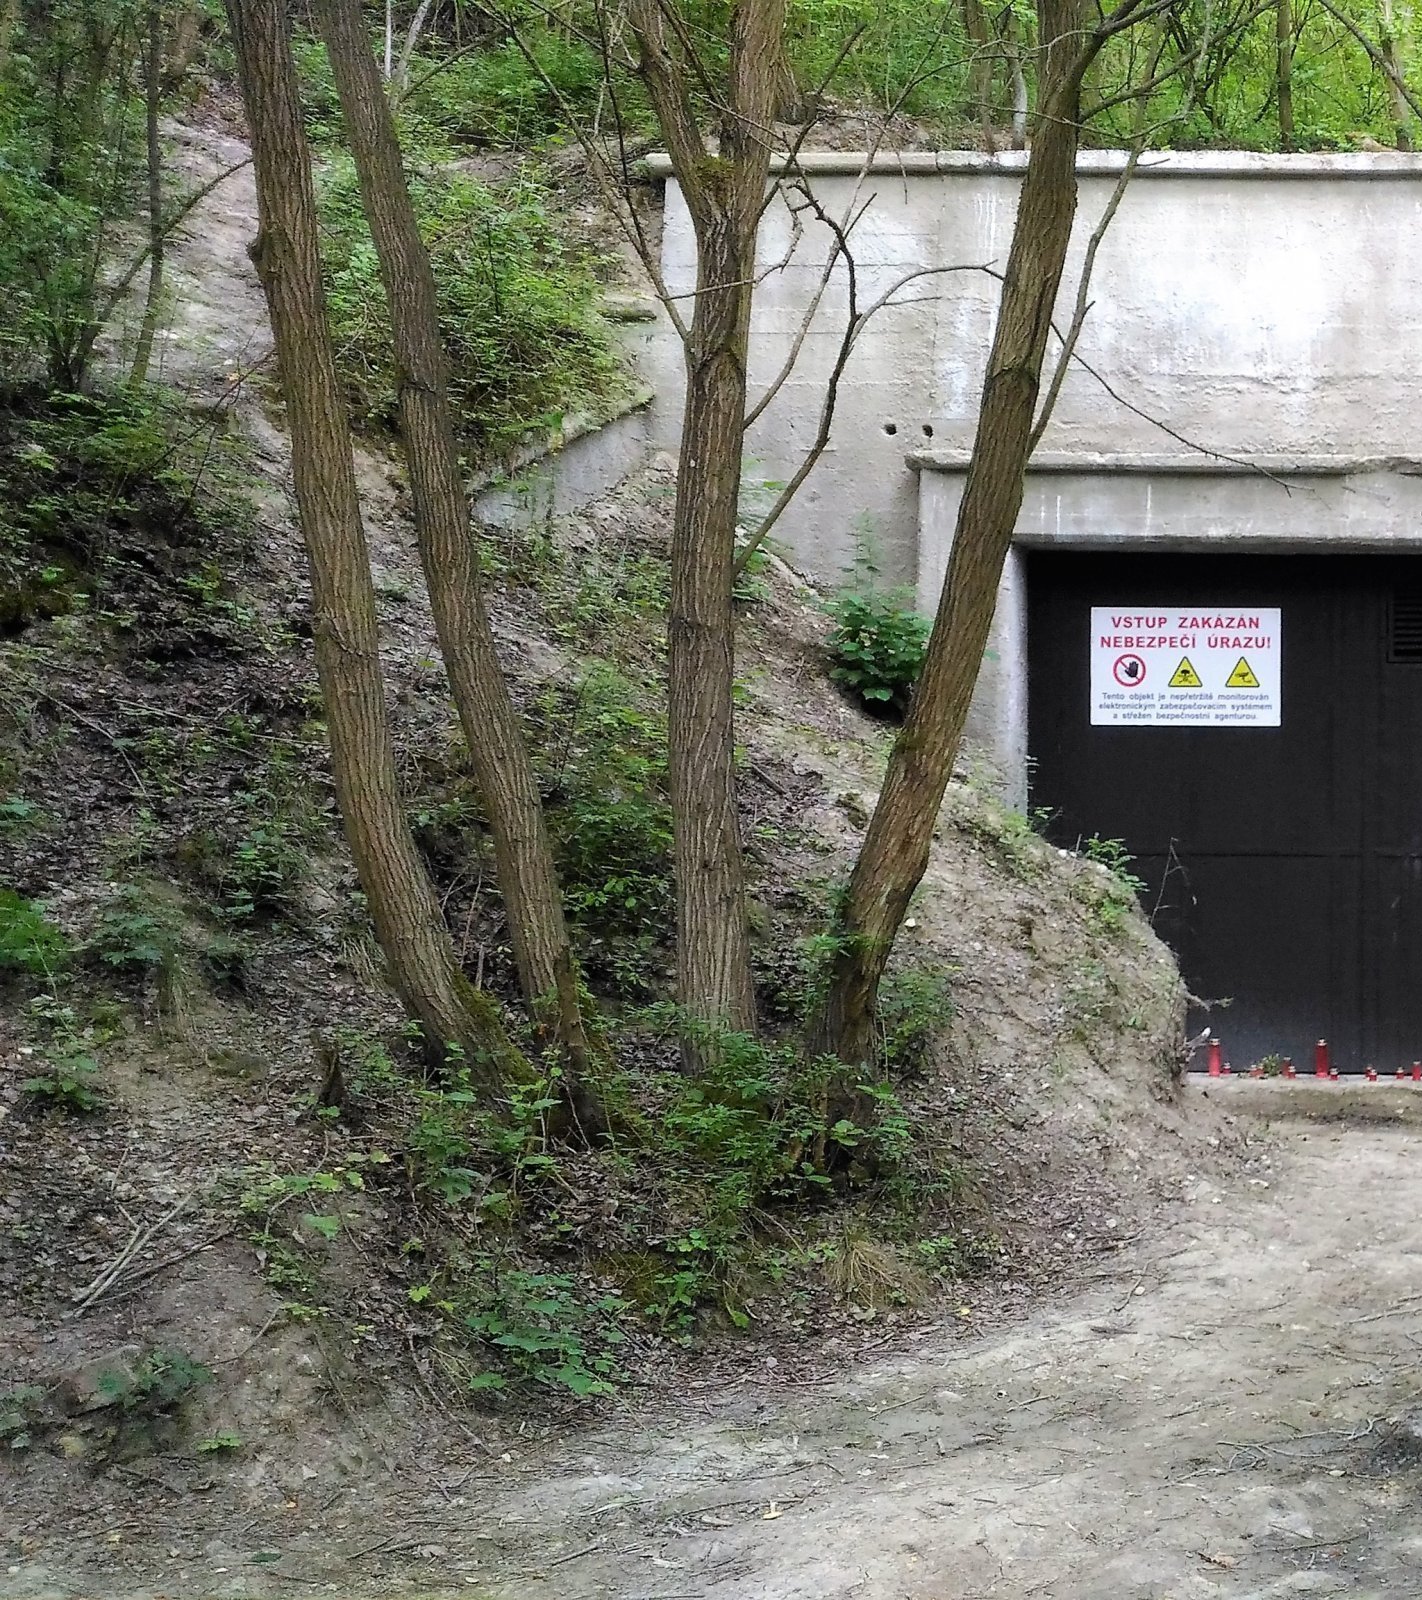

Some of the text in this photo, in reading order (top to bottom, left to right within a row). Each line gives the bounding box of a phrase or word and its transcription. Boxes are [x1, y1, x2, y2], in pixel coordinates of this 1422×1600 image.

[1111, 613, 1260, 629] VSTUP ZAKÁZÁN
[1100, 633, 1271, 648] NEBEZPEČÍ ÚRAZU!
[1102, 692, 1125, 700] Tento
[1129, 692, 1154, 701] objekt
[1158, 692, 1166, 702] je
[1217, 692, 1269, 700] monitorován
[1099, 702, 1155, 711] elektronickým
[1231, 702, 1272, 711] systémem
